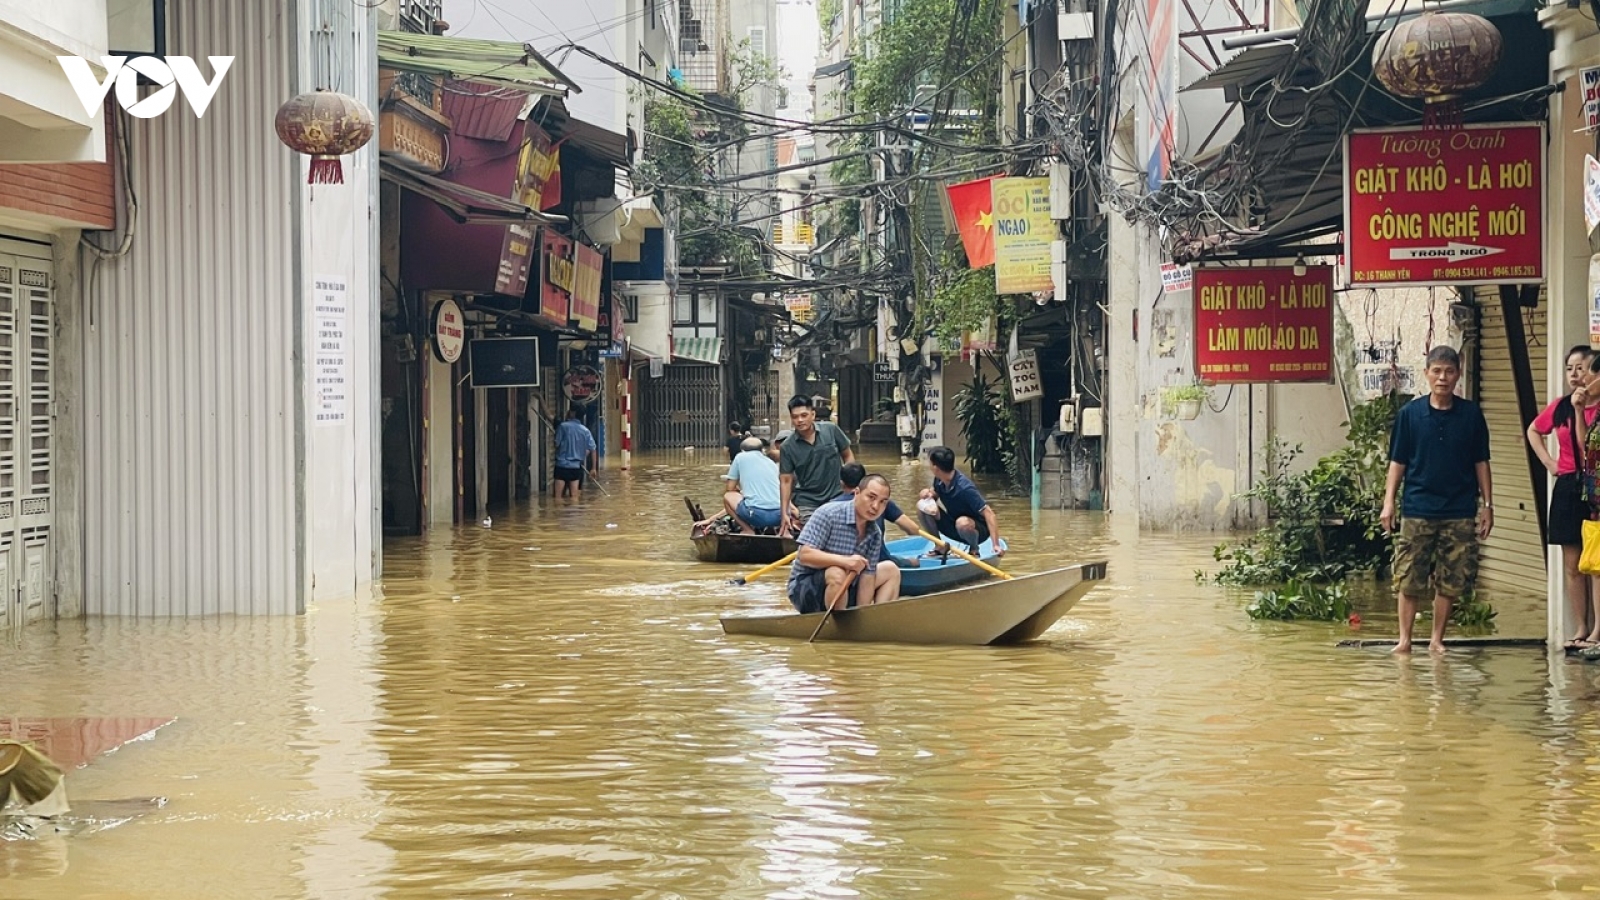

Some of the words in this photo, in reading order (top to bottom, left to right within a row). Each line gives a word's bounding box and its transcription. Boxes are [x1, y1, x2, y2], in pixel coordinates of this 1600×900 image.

[1450, 130, 1505, 150] Oanh
[1355, 163, 1399, 200] GIẶT
[1406, 160, 1447, 192] KHÔ
[1467, 158, 1492, 190] LÀ
[1500, 159, 1532, 188] HƠI
[997, 218, 1026, 236] NGAO
[1369, 207, 1422, 240] CÔNG
[1429, 205, 1480, 242] NGHỆ
[1488, 203, 1525, 236] MỚI
[1410, 249, 1455, 257] TRONG
[1201, 281, 1233, 315] GIẶT
[1236, 280, 1266, 310] KHÔ
[1280, 280, 1298, 309] LÀ
[1302, 281, 1326, 308] HƠI
[1209, 323, 1240, 351] LÀM
[1244, 322, 1272, 351] MỚI
[1275, 322, 1296, 350] ÁO
[1300, 326, 1319, 350] DA
[1015, 383, 1040, 396] NAM
